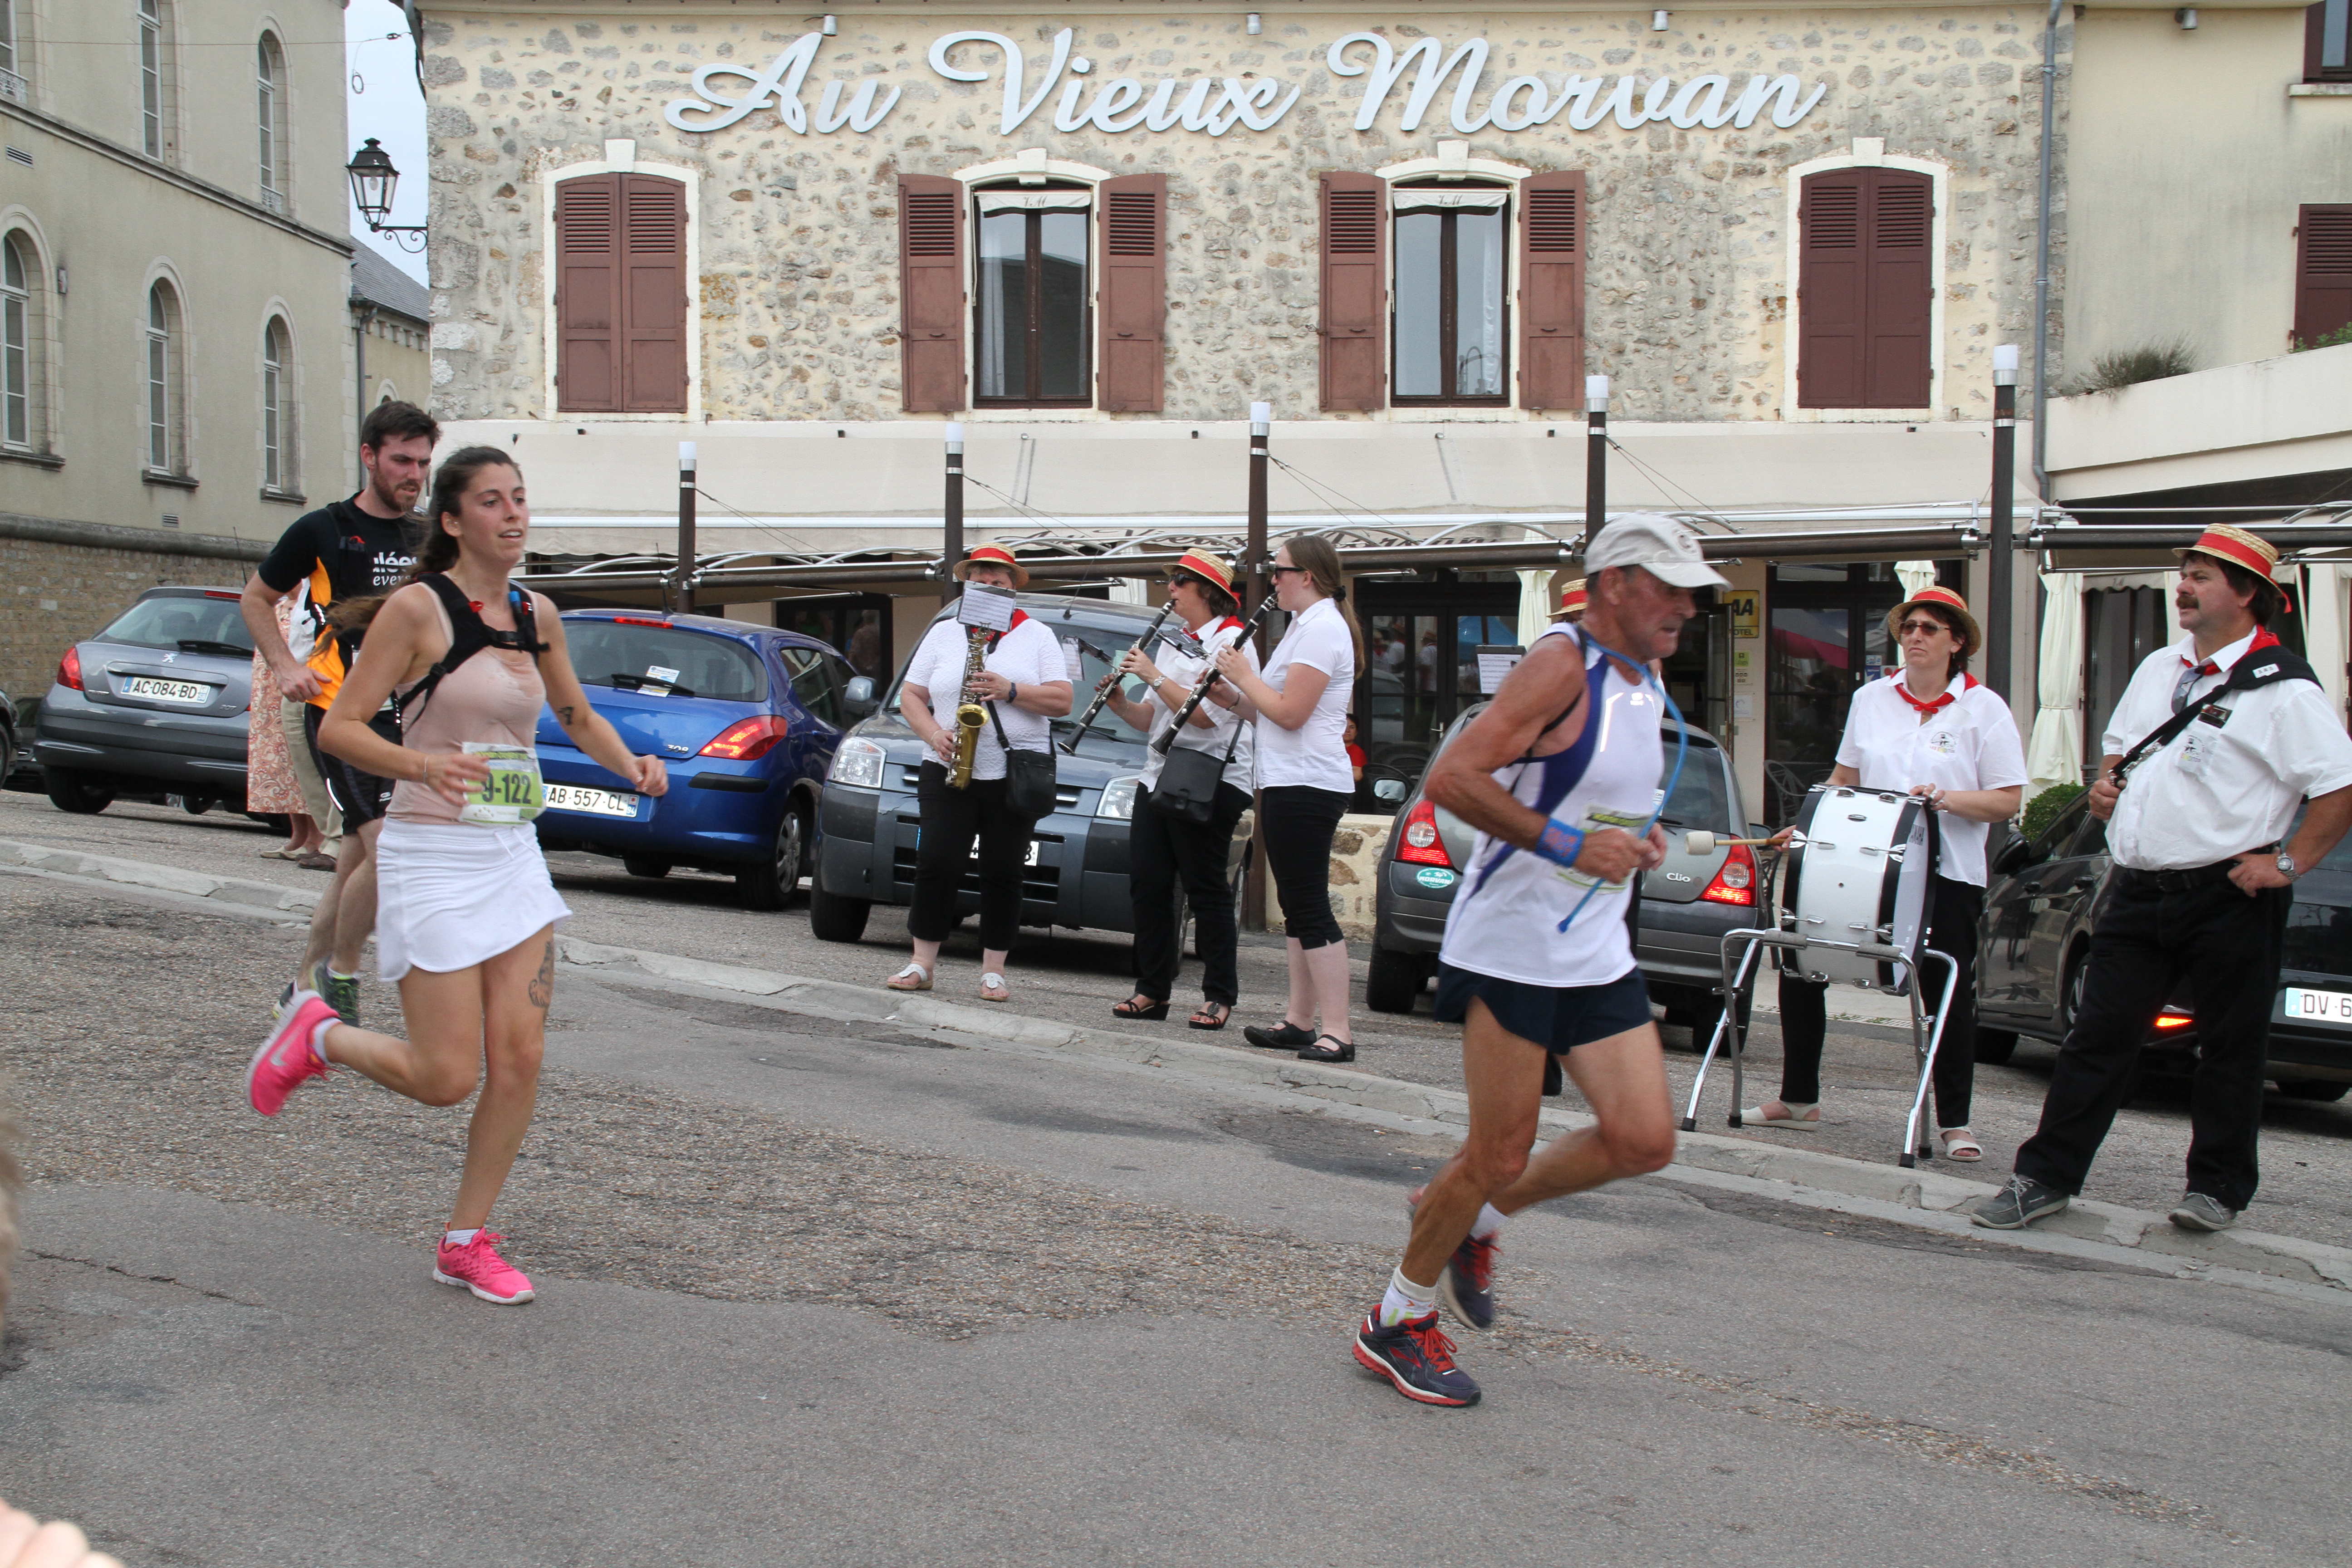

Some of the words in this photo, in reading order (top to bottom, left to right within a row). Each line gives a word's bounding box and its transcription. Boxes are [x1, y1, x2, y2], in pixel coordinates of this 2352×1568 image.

[664, 32, 901, 134] Au
[929, 28, 1301, 137] Vieux
[1327, 32, 1827, 132] Morvan
[132, 680, 197, 699] AC-084-BD
[665, 744, 689, 754] 308
[627, 806, 635, 814] 94
[1419, 876, 1451, 885] MORVAN
[1666, 872, 1691, 883] Clio
